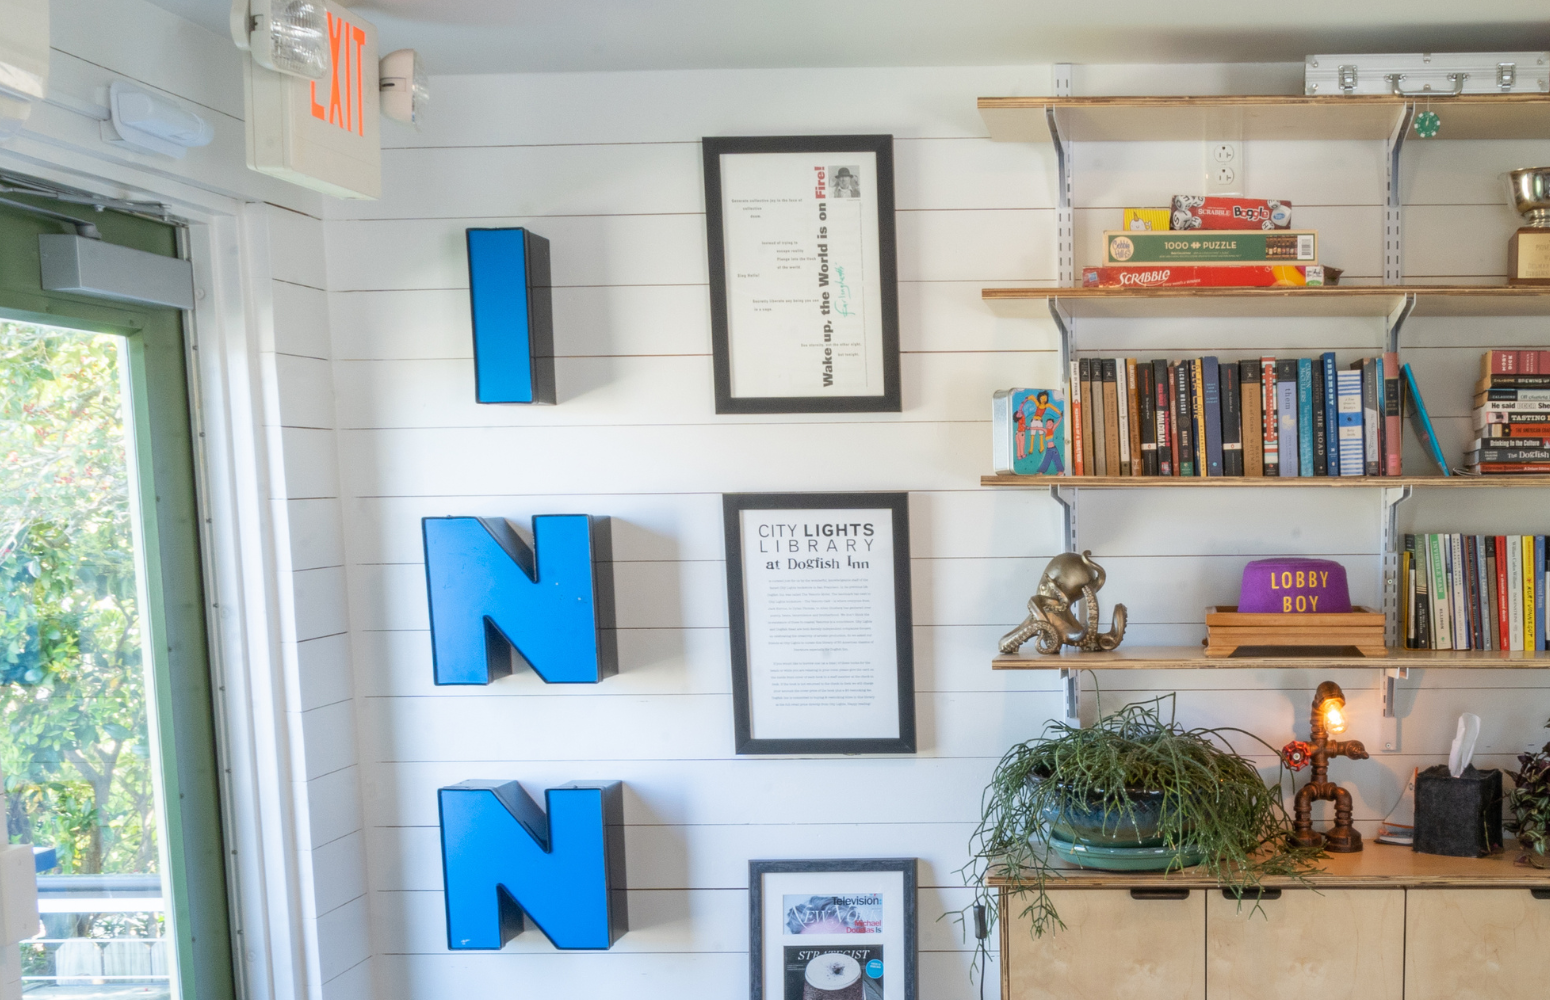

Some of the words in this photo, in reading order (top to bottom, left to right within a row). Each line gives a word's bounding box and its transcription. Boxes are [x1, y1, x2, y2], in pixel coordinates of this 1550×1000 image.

[815, 166, 826, 199] Fire!
[818, 202, 827, 221] on
[1233, 206, 1270, 222] Boggle
[817, 226, 827, 239] is
[1164, 241, 1189, 250] 1000
[1203, 241, 1237, 250] PUZZLE
[817, 244, 830, 287] World
[1119, 270, 1171, 286] SCRABBLE
[820, 291, 831, 315] the
[823, 320, 834, 343] up,
[822, 348, 834, 387] Wake
[1178, 368, 1186, 391] RICHARD
[1284, 388, 1292, 410] them
[1157, 410, 1165, 442] MALCOLM
[758, 524, 797, 538] CITY
[804, 523, 875, 537] LIGHTS
[760, 539, 874, 553] LIBRARY
[766, 559, 780, 570] at
[787, 557, 840, 570] Dogfish
[847, 555, 869, 569] Inn
[1432, 541, 1441, 576] INVISIBLE
[1271, 571, 1329, 589] LOBBY
[1283, 595, 1319, 613] BOY
[832, 896, 882, 906] Television:
